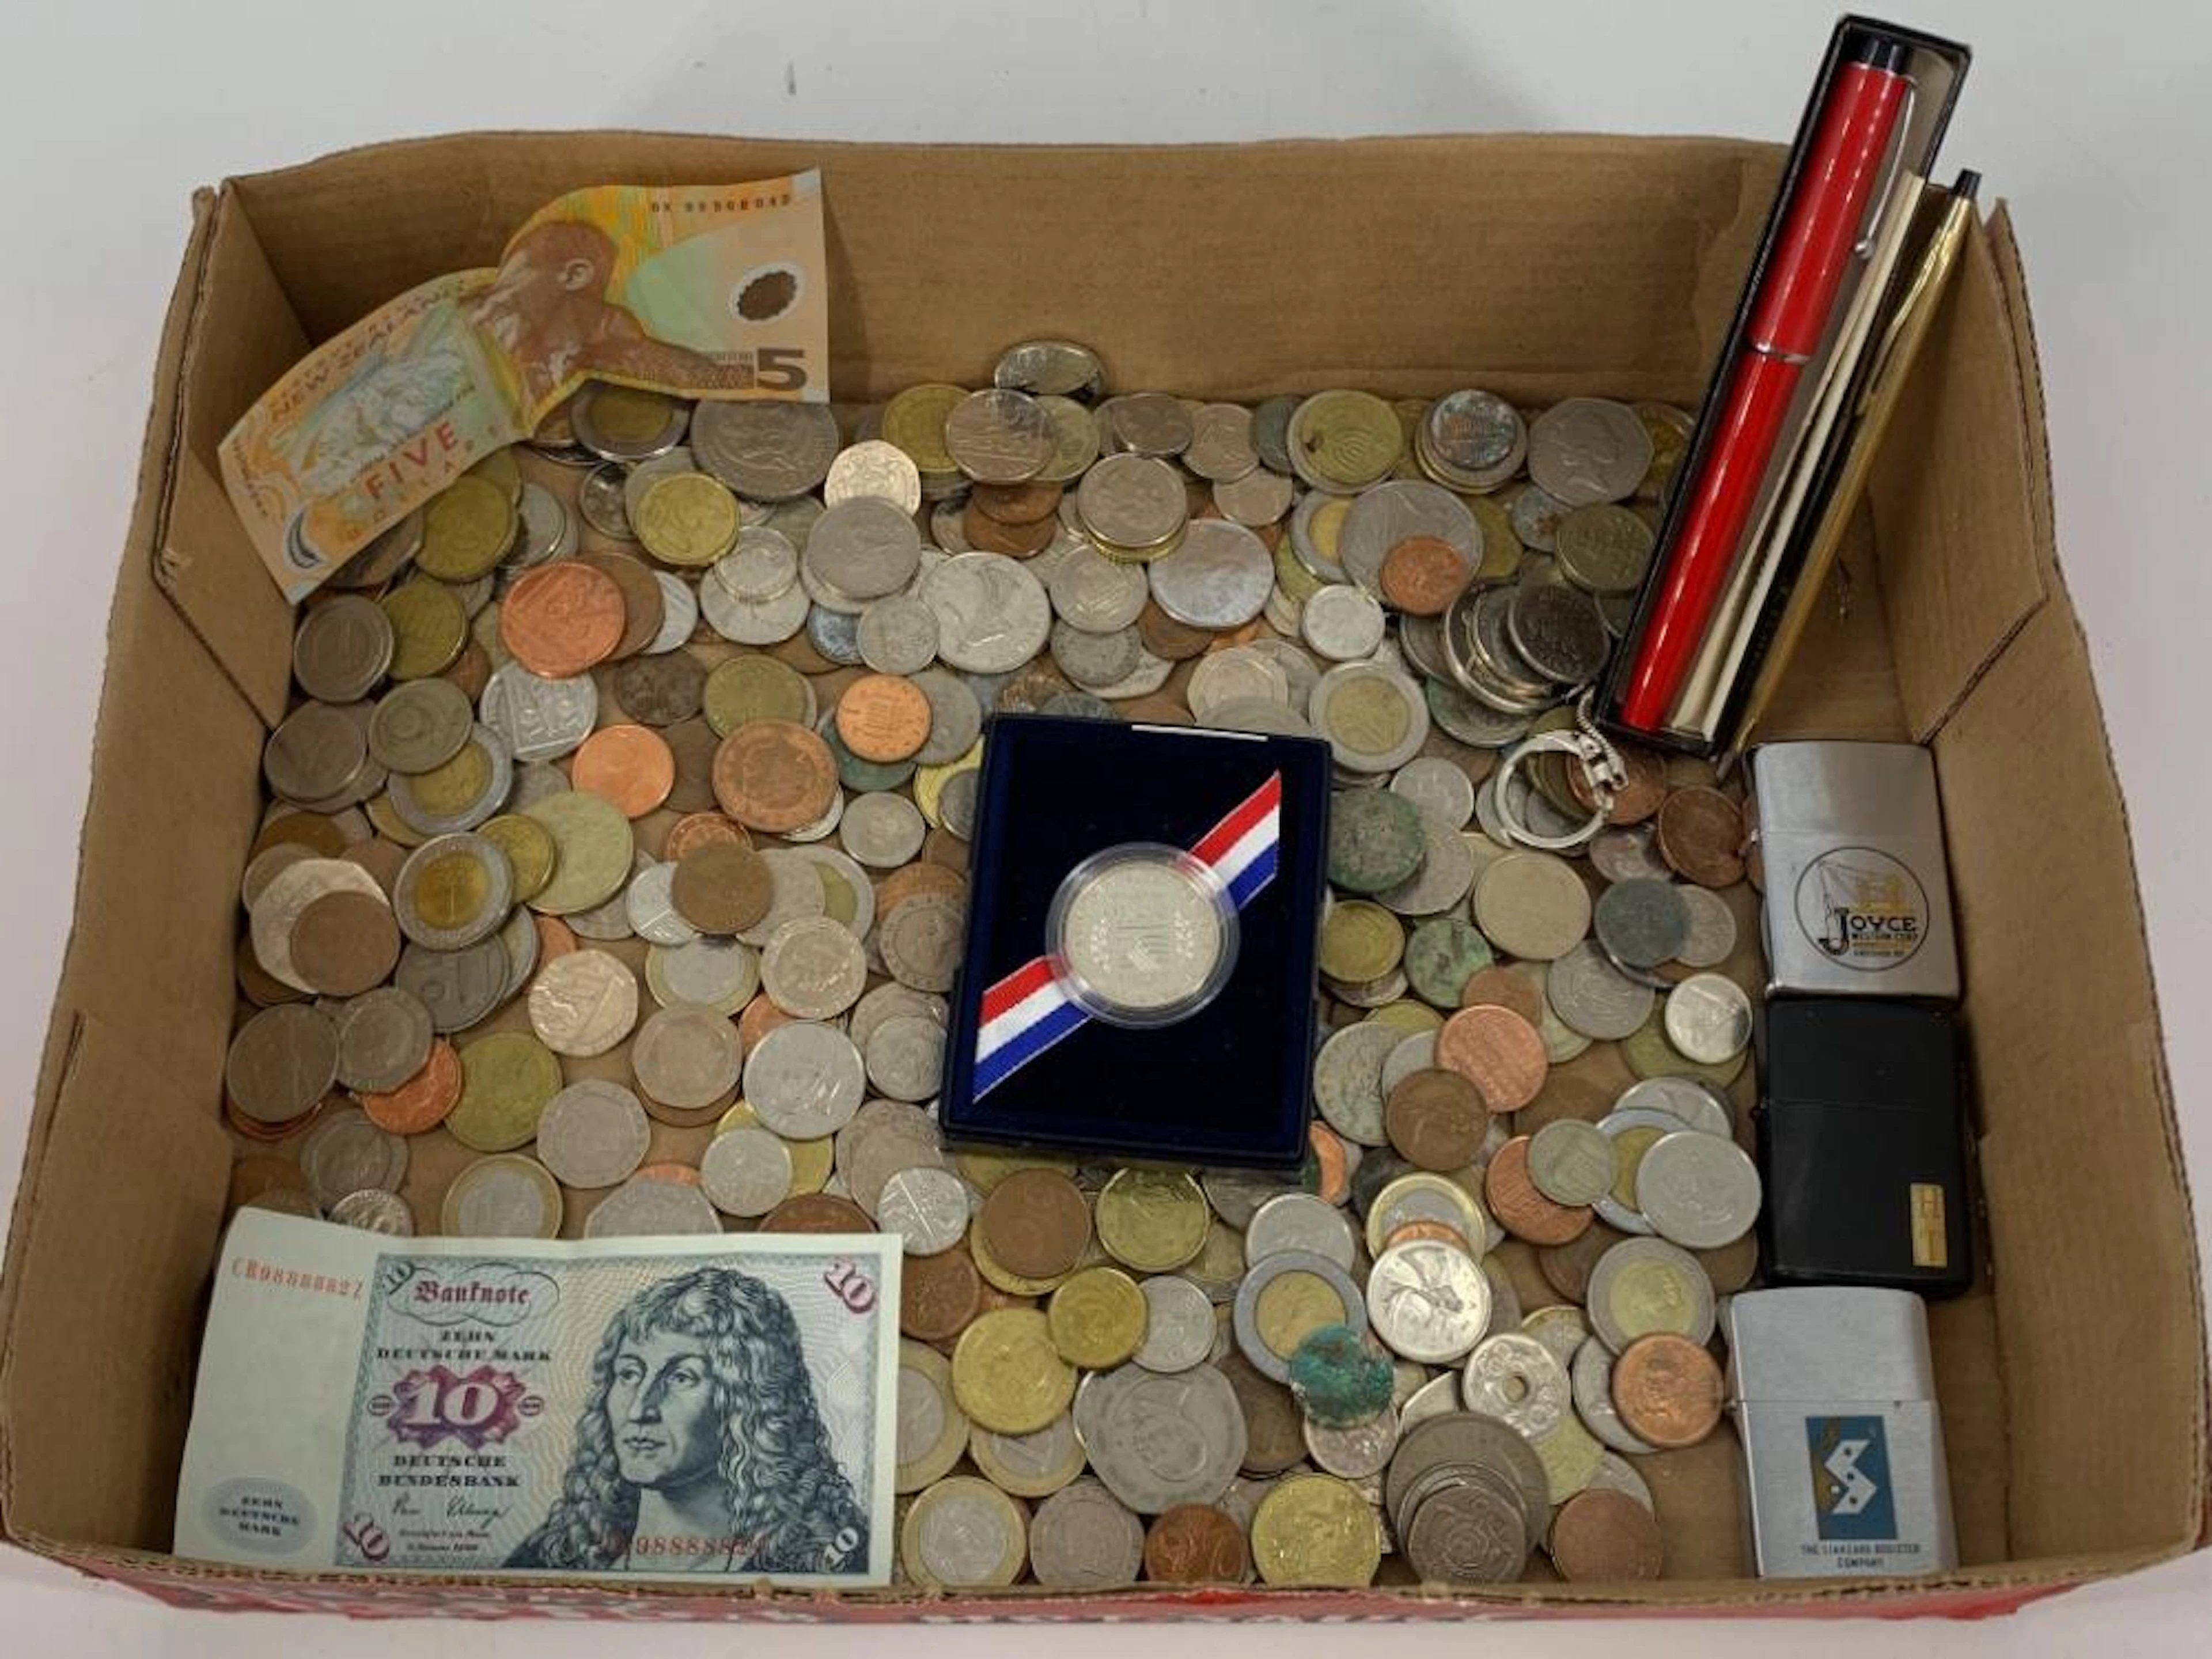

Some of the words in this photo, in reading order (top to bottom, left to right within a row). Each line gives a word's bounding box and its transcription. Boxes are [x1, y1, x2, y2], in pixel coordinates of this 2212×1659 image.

[757, 348, 808, 391] 5
[365, 421, 459, 499] FIVE
[1817, 907, 1916, 955] JOYCE
[414, 1279, 531, 1305] Banknote
[823, 1260, 877, 1315] 10
[377, 1347, 484, 1360] DEUTSCHE
[493, 1349, 551, 1362] MARK
[441, 1331, 495, 1343] ZEHN
[403, 1381, 500, 1428] 10
[377, 1474, 521, 1488] BUNDESBANK
[393, 1455, 507, 1467] DEUTSCHE
[342, 1514, 391, 1563] 10
